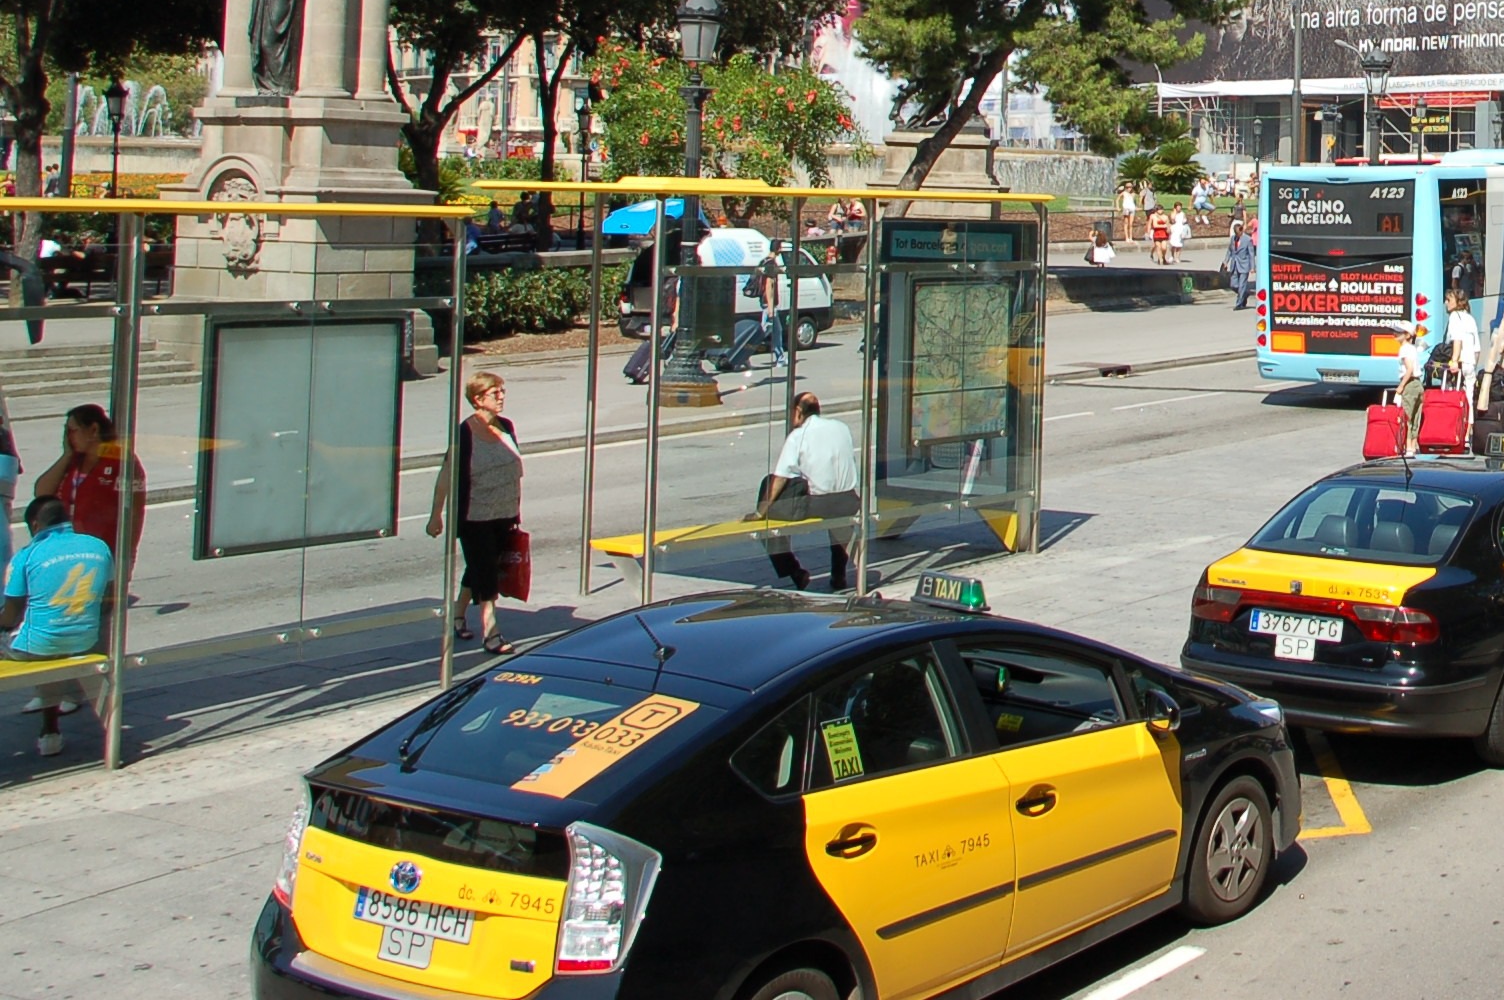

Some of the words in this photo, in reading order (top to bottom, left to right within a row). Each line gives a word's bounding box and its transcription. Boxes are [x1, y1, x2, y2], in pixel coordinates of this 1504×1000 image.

[1325, 3, 1360, 28] altra
[1366, 1, 1418, 26] forma
[1421, 34, 1450, 51] NEW
[1369, 187, 1406, 199] A123
[1287, 200, 1345, 214] CASINO
[1280, 213, 1353, 226] BARCELONA
[1381, 216, 1401, 233] A1
[894, 238, 908, 249] Tot
[1272, 263, 1302, 273] BUFFET
[1384, 264, 1405, 273] BARS
[1341, 272, 1360, 281] SLOT
[1361, 273, 1404, 282] MACHINES
[1272, 281, 1327, 292] BLACK-JACK
[1340, 281, 1404, 295] ROULETTE
[1272, 292, 1340, 312] POKER
[1340, 295, 1404, 304] DINNER-SHOWS
[1341, 303, 1404, 314] DISCOTHEQUE
[1274, 315, 1403, 328] www.casino-barcelona.com
[1311, 330, 1329, 338] PORT
[49, 561, 98, 616] 4
[935, 577, 962, 601] TAXI
[1261, 612, 1300, 634] 3767
[1307, 617, 1338, 638] CFG
[1281, 637, 1309, 657] SP
[641, 708, 666, 722] T
[501, 709, 552, 728] 933
[547, 717, 600, 738] 033
[593, 726, 645, 748] 033
[834, 755, 861, 779] TAXI
[914, 848, 940, 868] TAXI
[960, 833, 990, 855] 7945
[458, 884, 477, 901] dc.
[509, 892, 556, 915] 7945
[368, 889, 422, 926] 8586
[425, 903, 470, 938] HCH
[387, 928, 427, 959] SP
